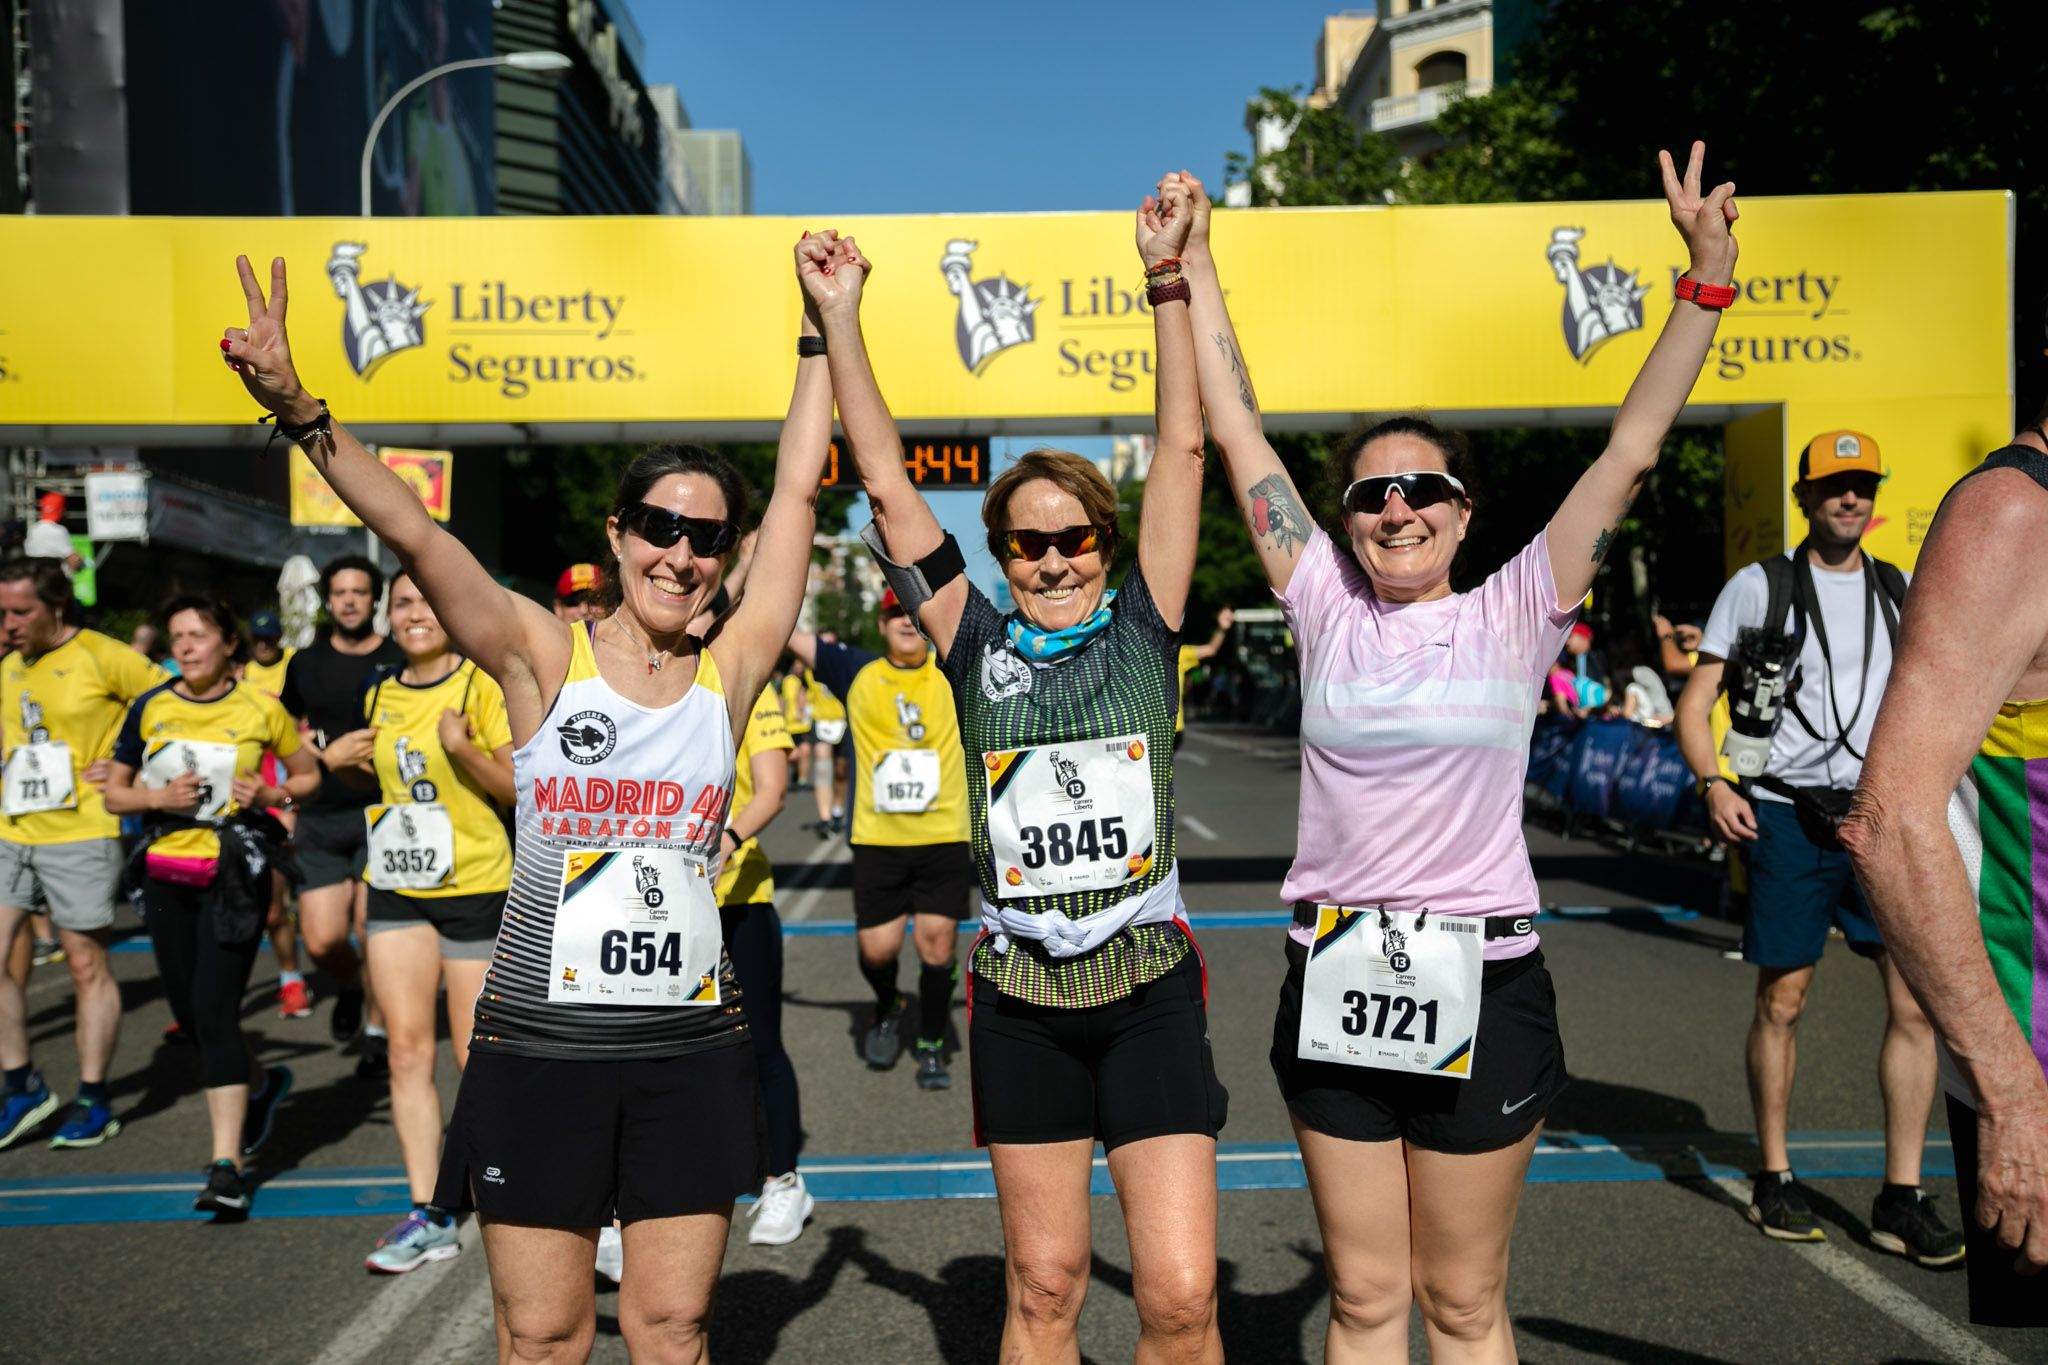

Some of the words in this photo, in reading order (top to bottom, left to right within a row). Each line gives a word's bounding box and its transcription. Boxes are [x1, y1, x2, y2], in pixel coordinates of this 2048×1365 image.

[1061, 276, 1155, 318] Libe
[449, 280, 626, 339] Liberty
[570, 711, 603, 723] TIGERS
[600, 720, 616, 758] RUNNING
[569, 753, 593, 764] CLUB
[534, 776, 685, 817] MADRID
[887, 781, 924, 799] 1672
[1069, 782, 1083, 796] 13
[1074, 803, 1094, 811] Liberty
[542, 817, 672, 839] MARATÓN
[566, 839, 609, 848] MARATHON
[619, 841, 646, 849] AFTER
[1020, 815, 1128, 870] 3845
[383, 847, 437, 873] 3352
[648, 892, 661, 904] 13
[649, 914, 669, 922] Liberty
[600, 929, 683, 977] 654
[1393, 956, 1407, 969] 13
[1395, 973, 1416, 981] Carrera
[1395, 979, 1416, 988] Liberty
[1341, 989, 1439, 1046] 3721
